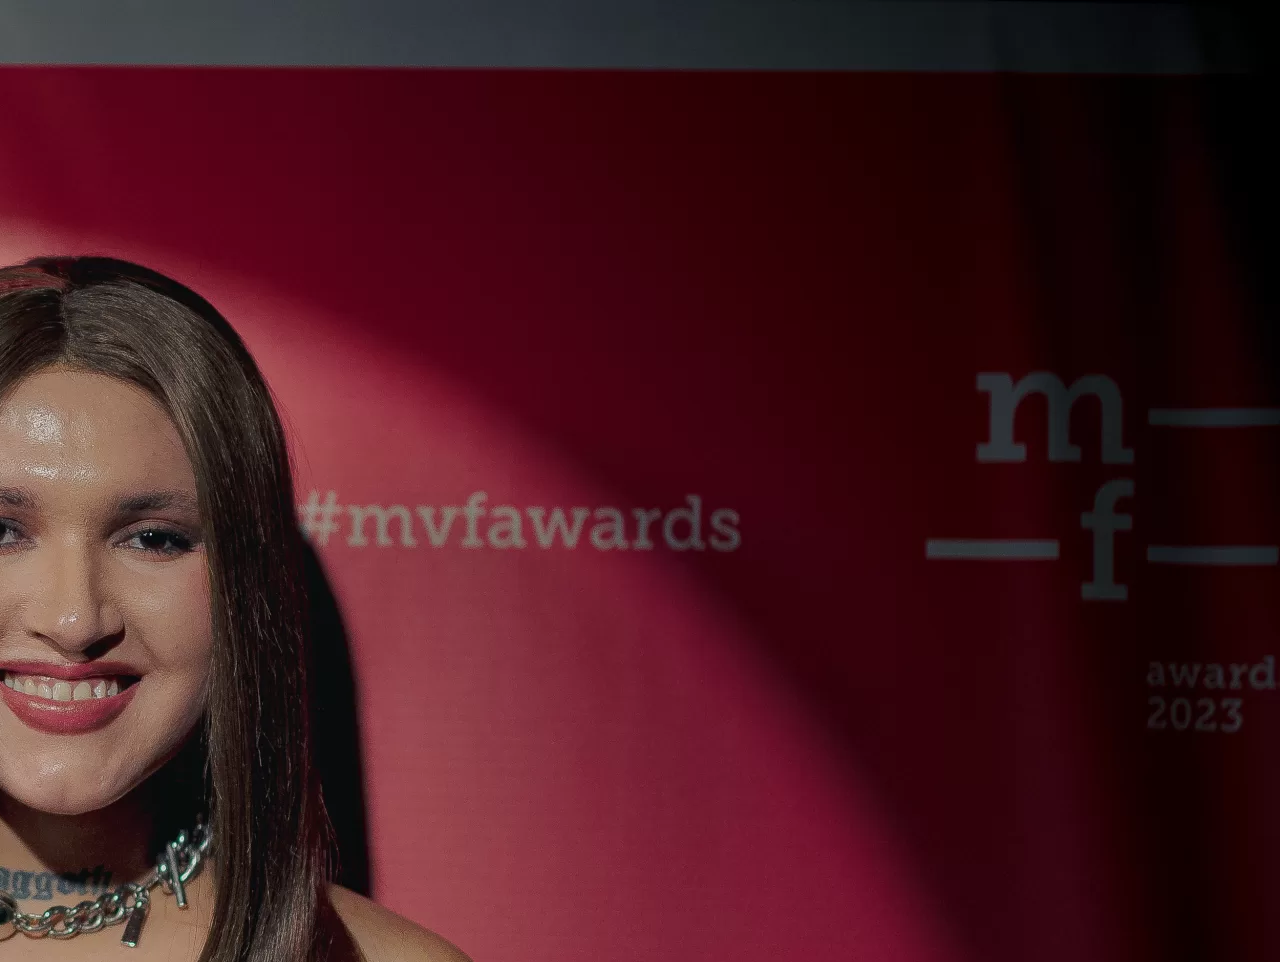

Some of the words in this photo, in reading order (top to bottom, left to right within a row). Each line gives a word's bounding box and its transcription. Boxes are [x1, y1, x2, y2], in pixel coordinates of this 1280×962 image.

[294, 488, 742, 551] #mvfawards
[1145, 654, 1280, 691] award
[1146, 695, 1245, 734] 2023
